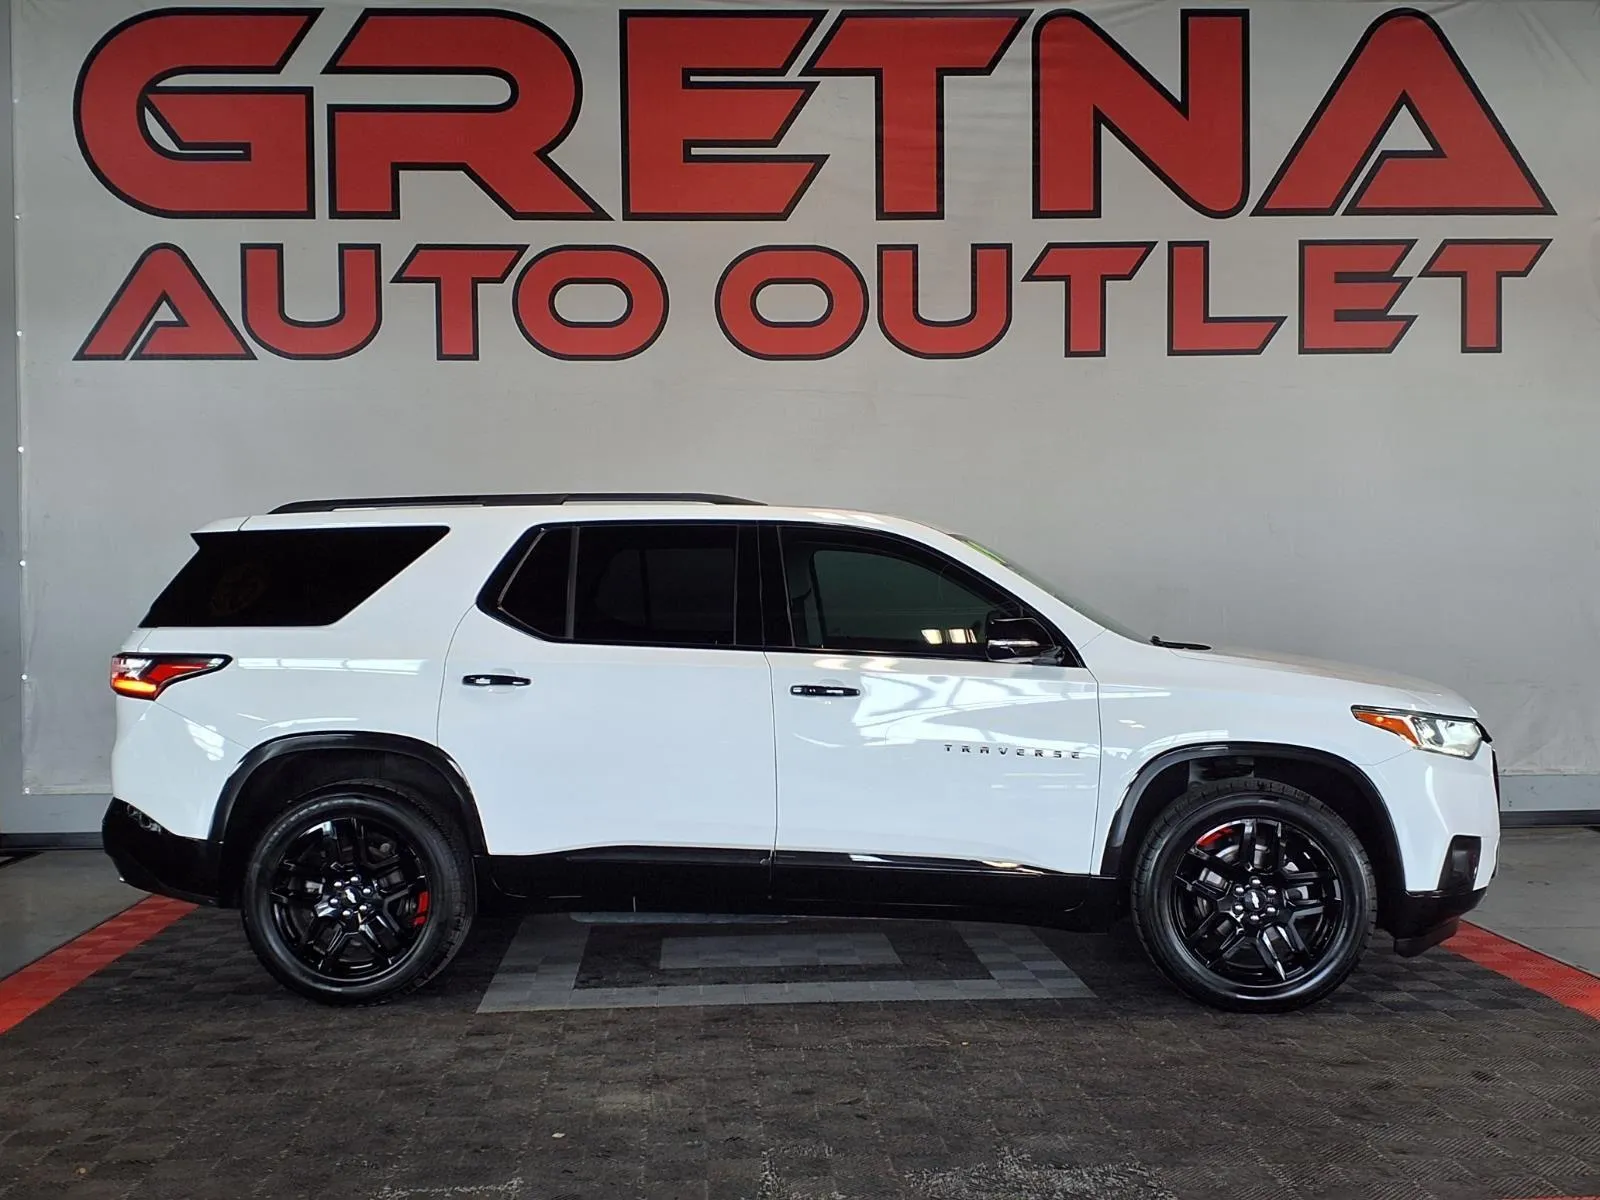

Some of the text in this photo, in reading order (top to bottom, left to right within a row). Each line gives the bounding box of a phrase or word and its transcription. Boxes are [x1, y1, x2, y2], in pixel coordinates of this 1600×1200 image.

[74, 8, 1557, 221] GRETNA
[73, 238, 1553, 361] AUTO OUTLET
[943, 744, 1081, 759] TRAVERSE
